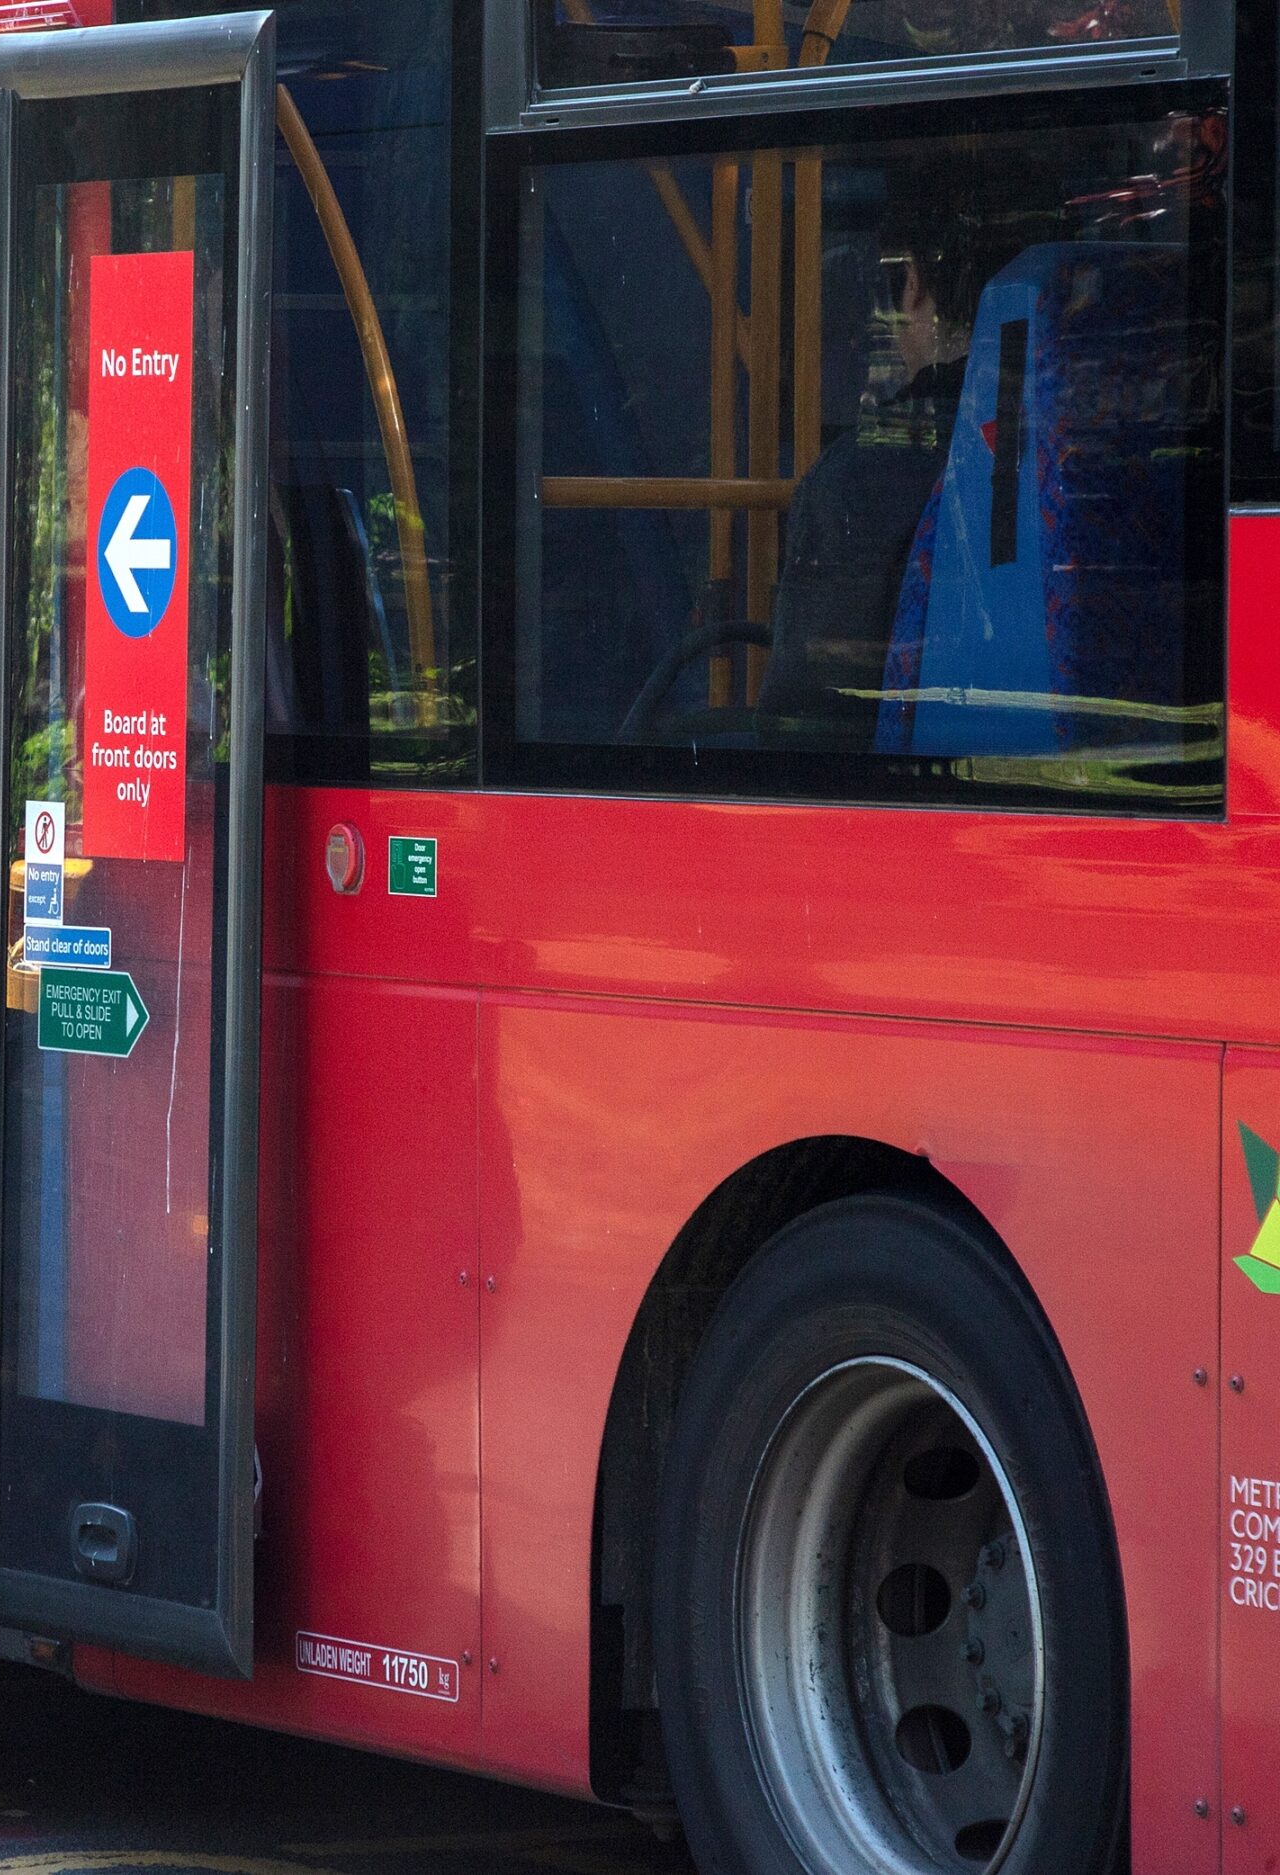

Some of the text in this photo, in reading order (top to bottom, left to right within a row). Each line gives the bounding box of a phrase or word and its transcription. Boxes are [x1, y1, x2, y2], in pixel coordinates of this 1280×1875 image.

[102, 347, 179, 382] No Entry
[104, 709, 166, 736] Board at
[92, 741, 177, 769] front doors
[117, 776, 150, 807] only
[408, 855, 432, 864] emergency
[28, 867, 60, 885] No entry
[28, 894, 46, 906] except
[26, 935, 108, 956] Stand clear of doors
[46, 984, 122, 1005] EMERGENCY EXIT
[51, 1002, 111, 1022] PULL & SLIDE
[61, 1021, 102, 1041] TO OPEN
[1230, 1542, 1267, 1575] 329
[299, 1640, 450, 1690] UNLADEN WEIGHT 11750 kg
